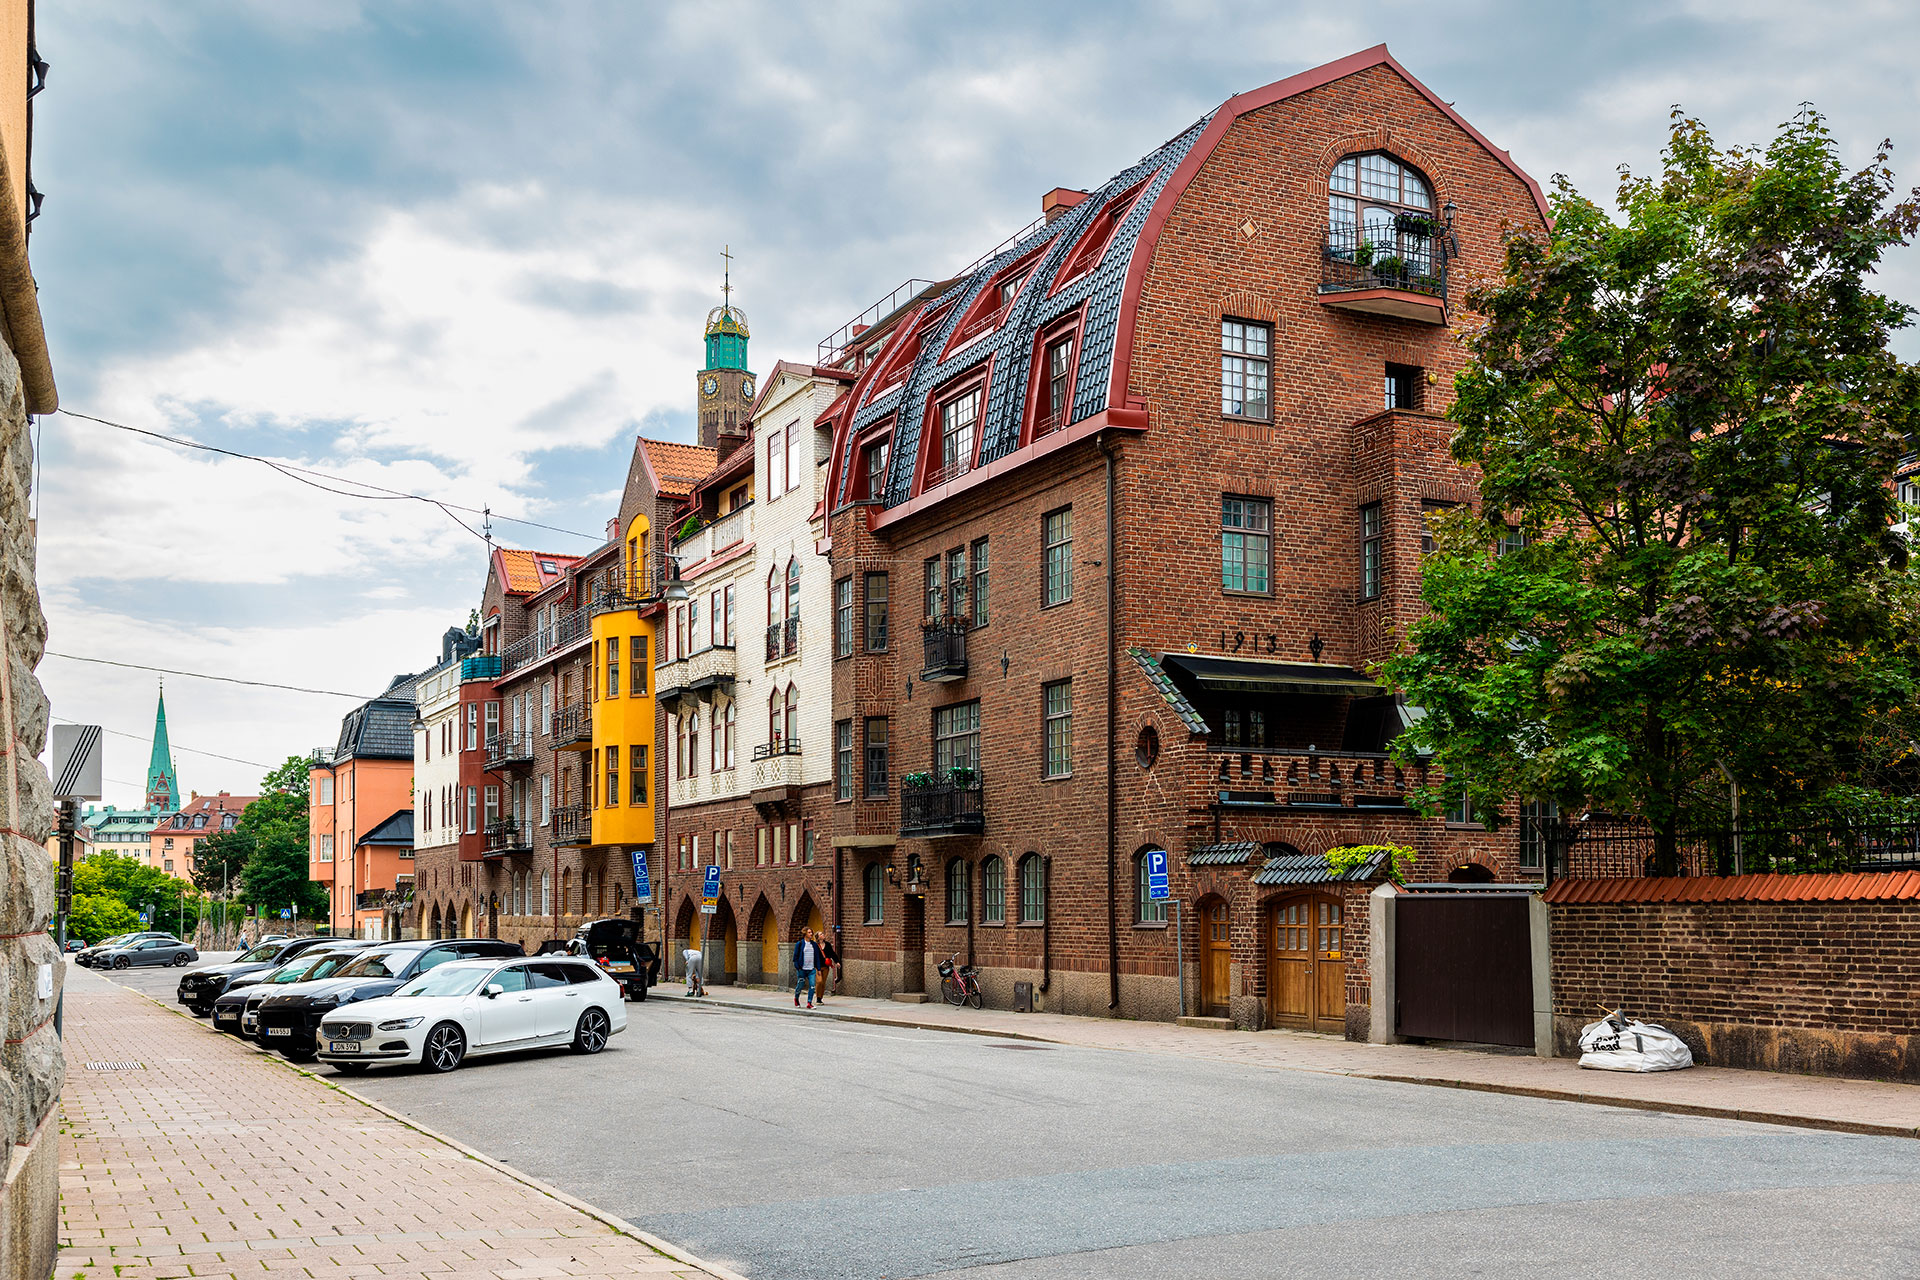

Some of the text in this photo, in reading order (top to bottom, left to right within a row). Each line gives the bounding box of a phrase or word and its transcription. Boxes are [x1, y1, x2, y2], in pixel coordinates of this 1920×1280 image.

[1221, 630, 1277, 654] 1913
[635, 853, 643, 864] P
[1152, 854, 1163, 873] P
[708, 867, 718, 880] P
[1591, 1040, 1621, 1052] Head
